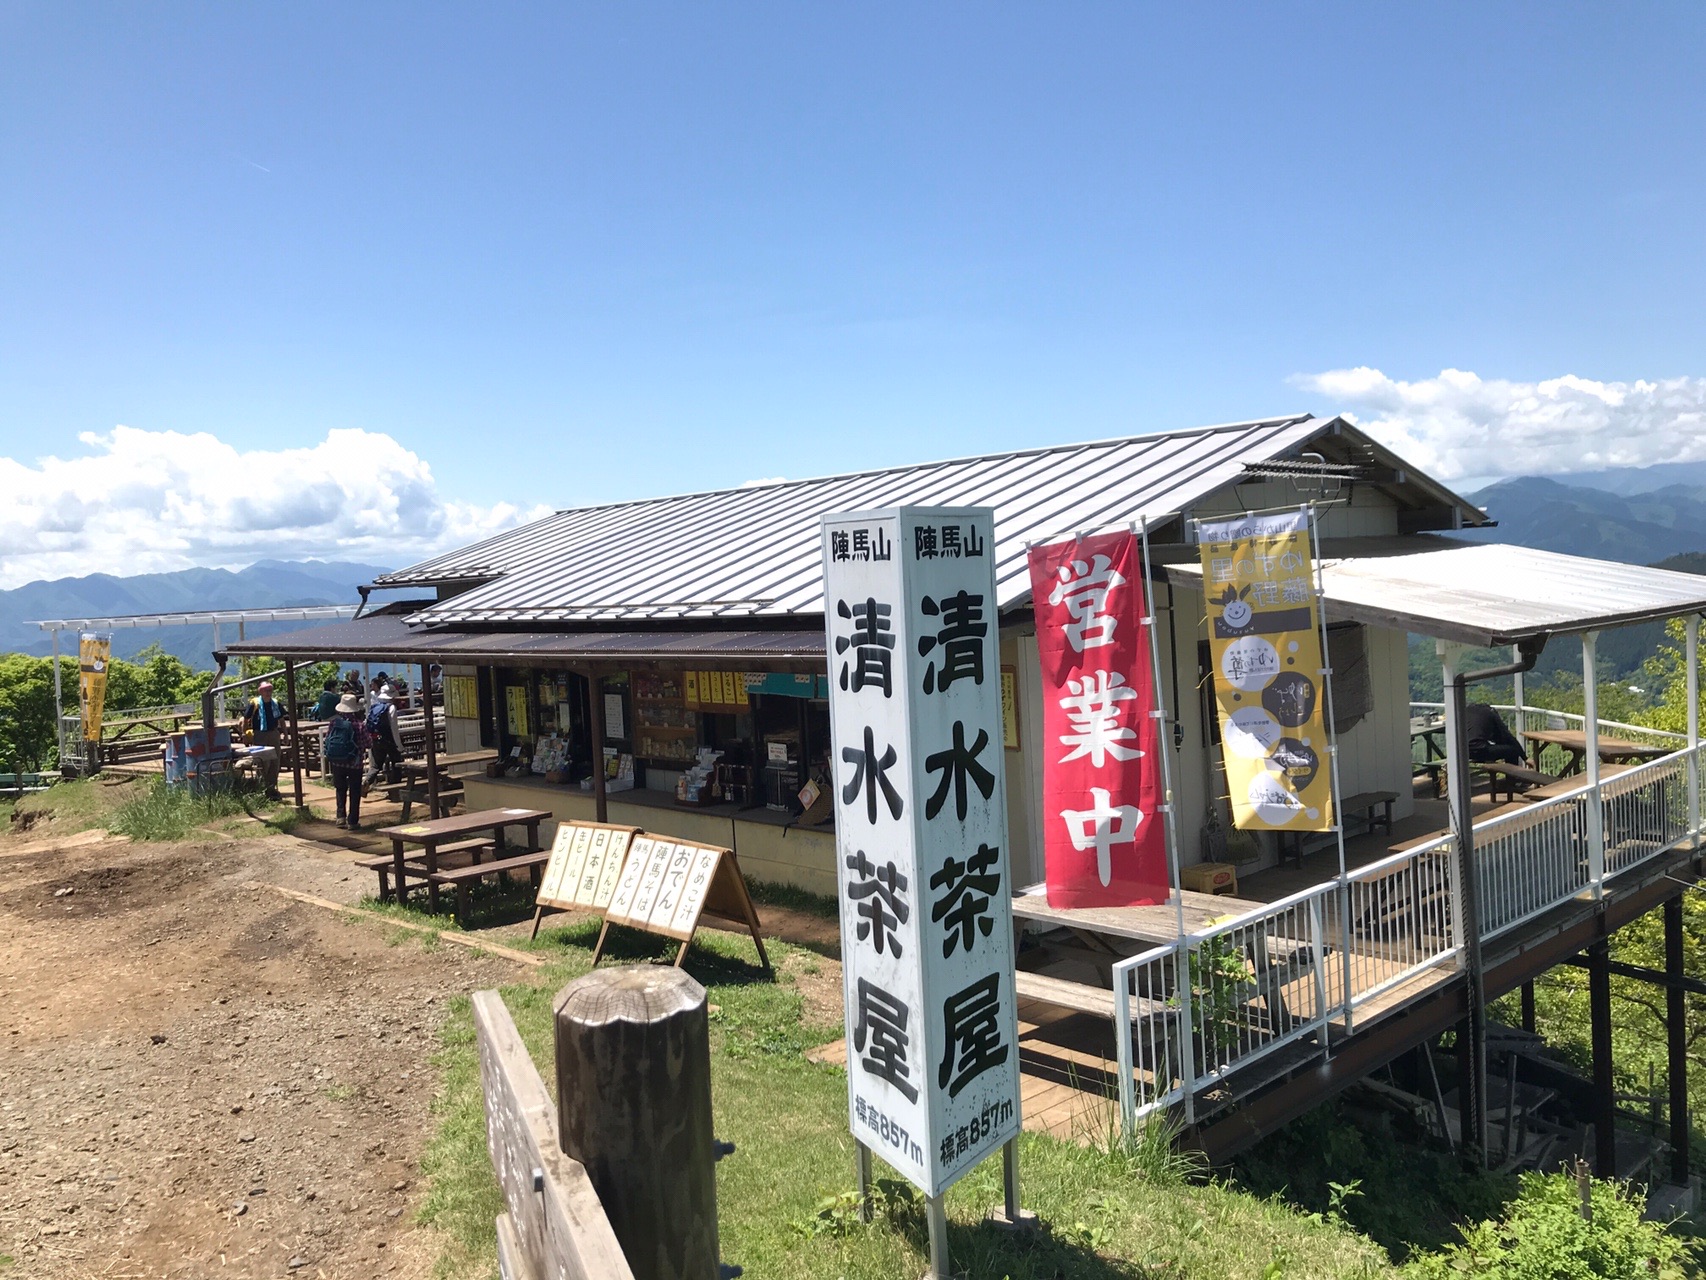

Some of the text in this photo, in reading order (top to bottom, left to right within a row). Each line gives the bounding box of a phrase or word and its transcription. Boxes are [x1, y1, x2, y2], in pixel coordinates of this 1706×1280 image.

[508, 688, 516, 726] ラムネ
[1048, 553, 1146, 888] 営業中
[583, 833, 605, 890] 日本酒
[600, 833, 624, 901] けんちん汁
[835, 596, 919, 1105] 清水茶屋
[917, 589, 1009, 1099] 清水茶屋
[658, 849, 691, 910] おでん
[680, 854, 712, 920] なめこ汁
[855, 1094, 924, 1167] 標高857m
[940, 1098, 1014, 1167] 標高857m
